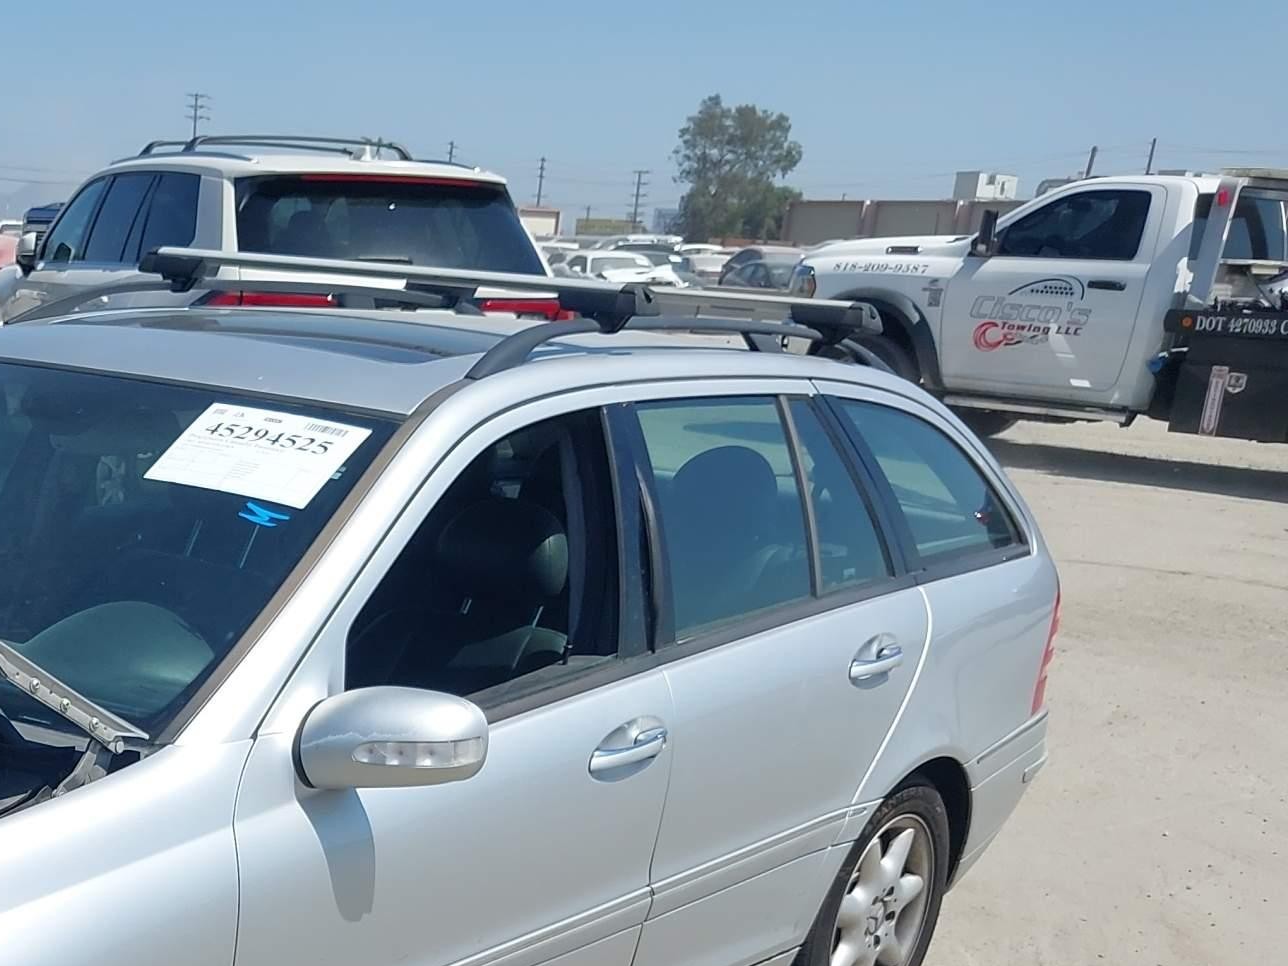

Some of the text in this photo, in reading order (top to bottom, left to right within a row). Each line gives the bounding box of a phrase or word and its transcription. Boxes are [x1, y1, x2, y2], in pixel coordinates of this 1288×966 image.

[970, 296, 1092, 326] Cisco's
[1001, 321, 1083, 336] Towing LLC
[1195, 315, 1226, 331] DOT
[205, 422, 334, 455] 45294525
